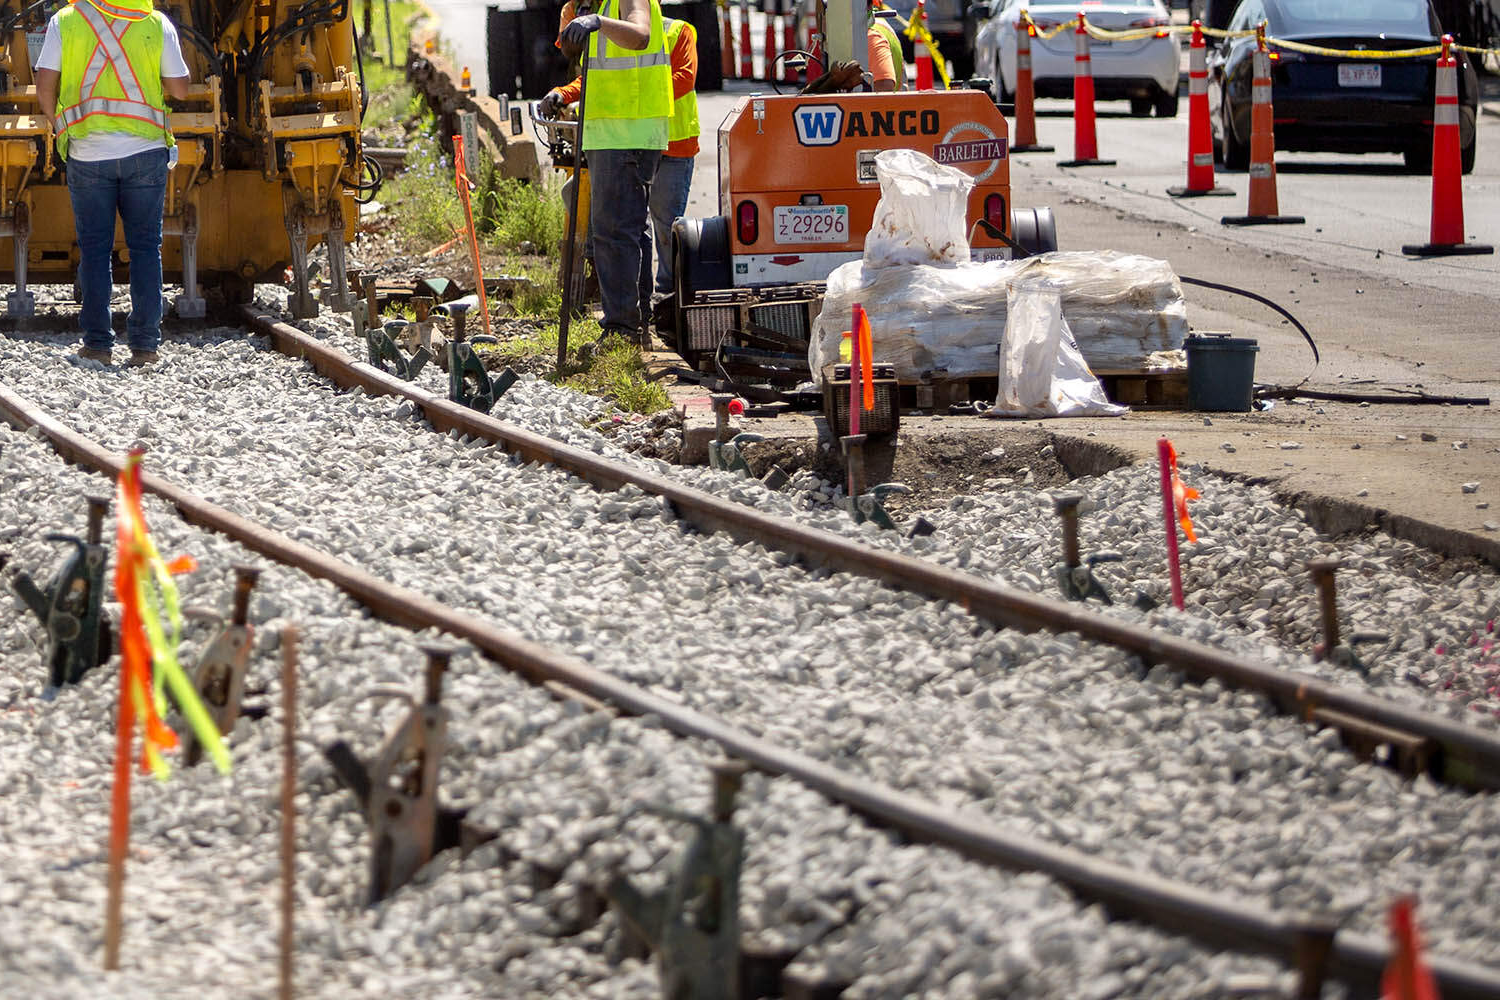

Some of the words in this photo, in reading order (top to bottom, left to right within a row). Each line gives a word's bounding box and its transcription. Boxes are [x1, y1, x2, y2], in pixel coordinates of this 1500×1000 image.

[801, 110, 940, 138] WANCO
[938, 142, 1001, 163] BARLETTA
[793, 215, 844, 233] 29296
